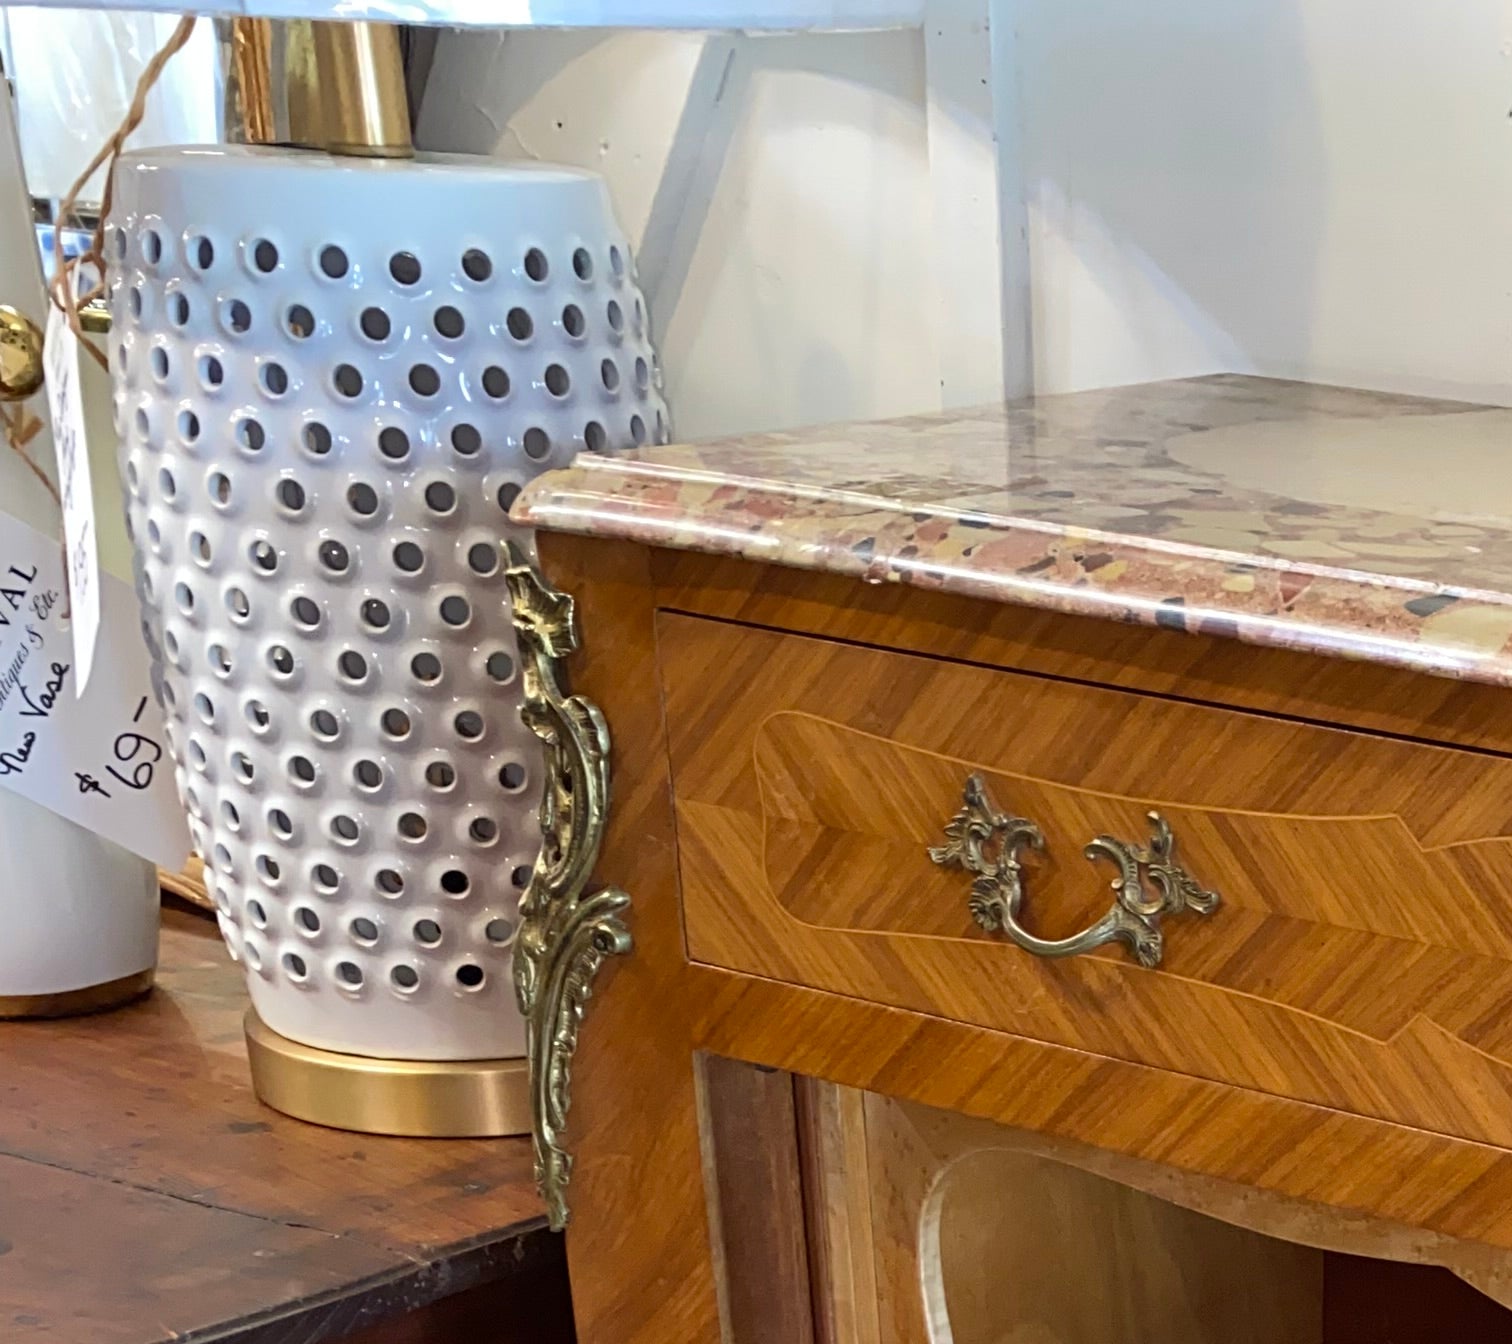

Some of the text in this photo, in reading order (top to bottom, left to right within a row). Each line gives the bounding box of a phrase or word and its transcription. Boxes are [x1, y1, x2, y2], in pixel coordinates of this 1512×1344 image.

[29, 590, 59, 621] Etc.
[25, 624, 44, 650] &
[19, 662, 70, 717] Vase
